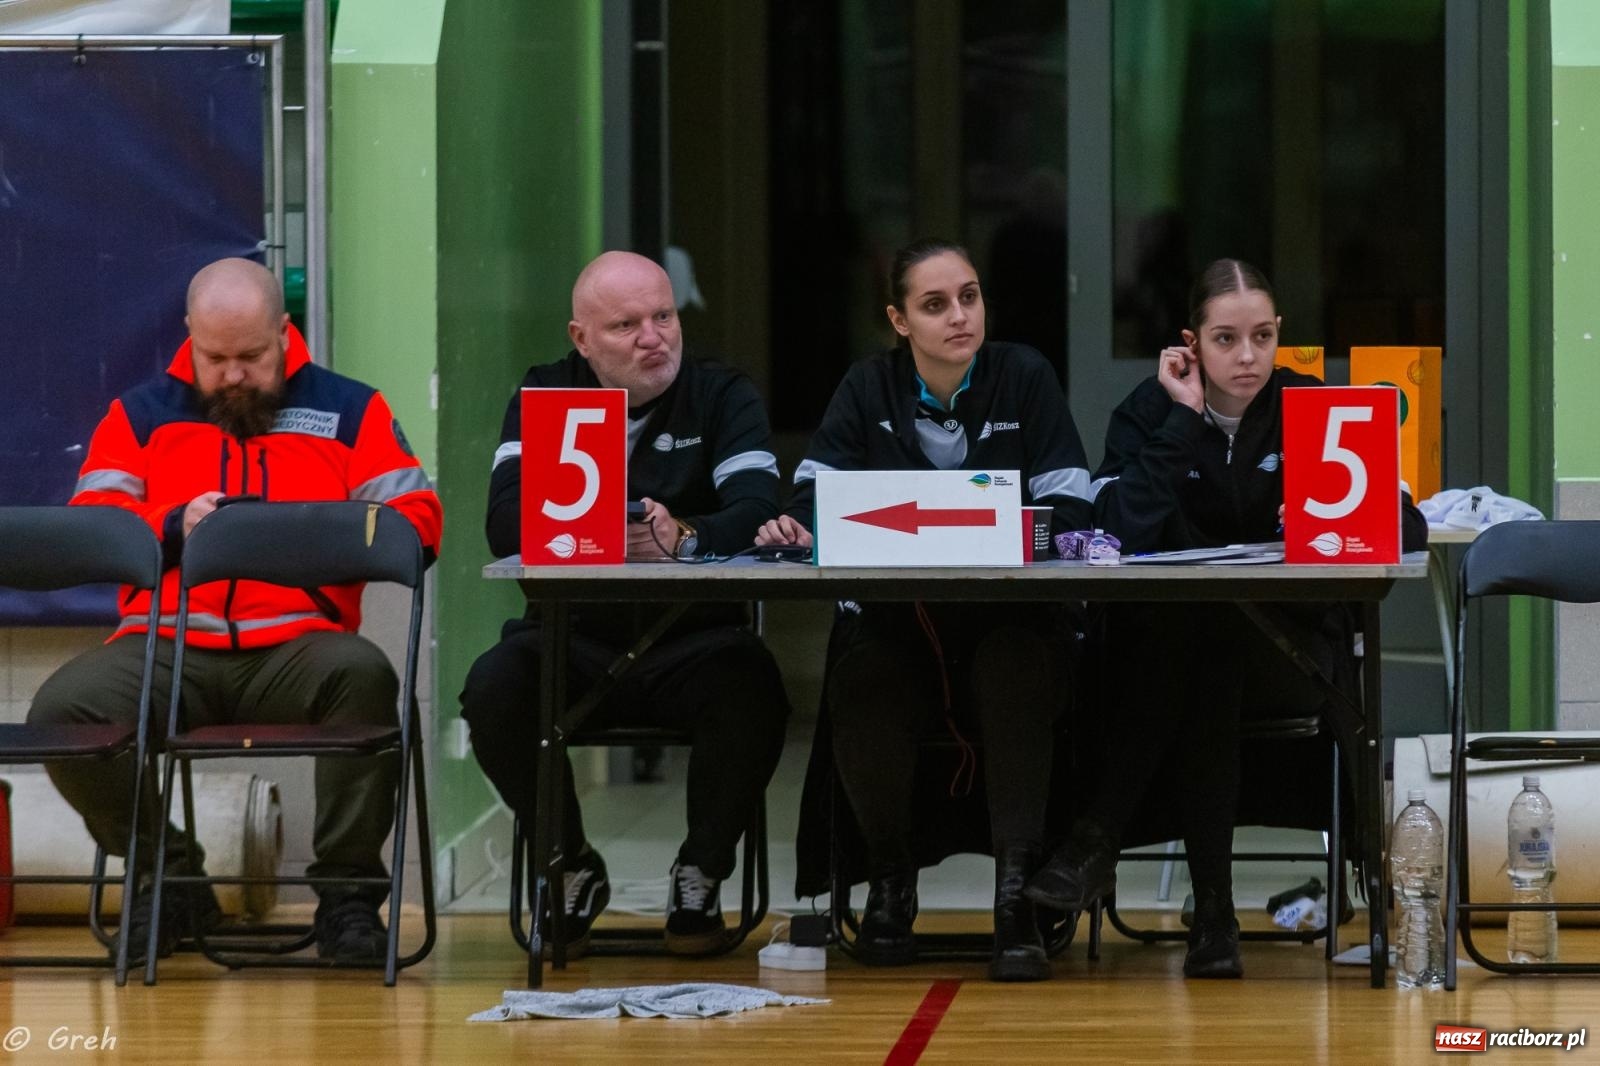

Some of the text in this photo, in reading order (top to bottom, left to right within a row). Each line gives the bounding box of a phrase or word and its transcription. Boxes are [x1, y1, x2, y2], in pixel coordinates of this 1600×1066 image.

[278, 410, 335, 423] ATOWNIK
[541, 408, 606, 521] 5
[1303, 406, 1373, 519] 5
